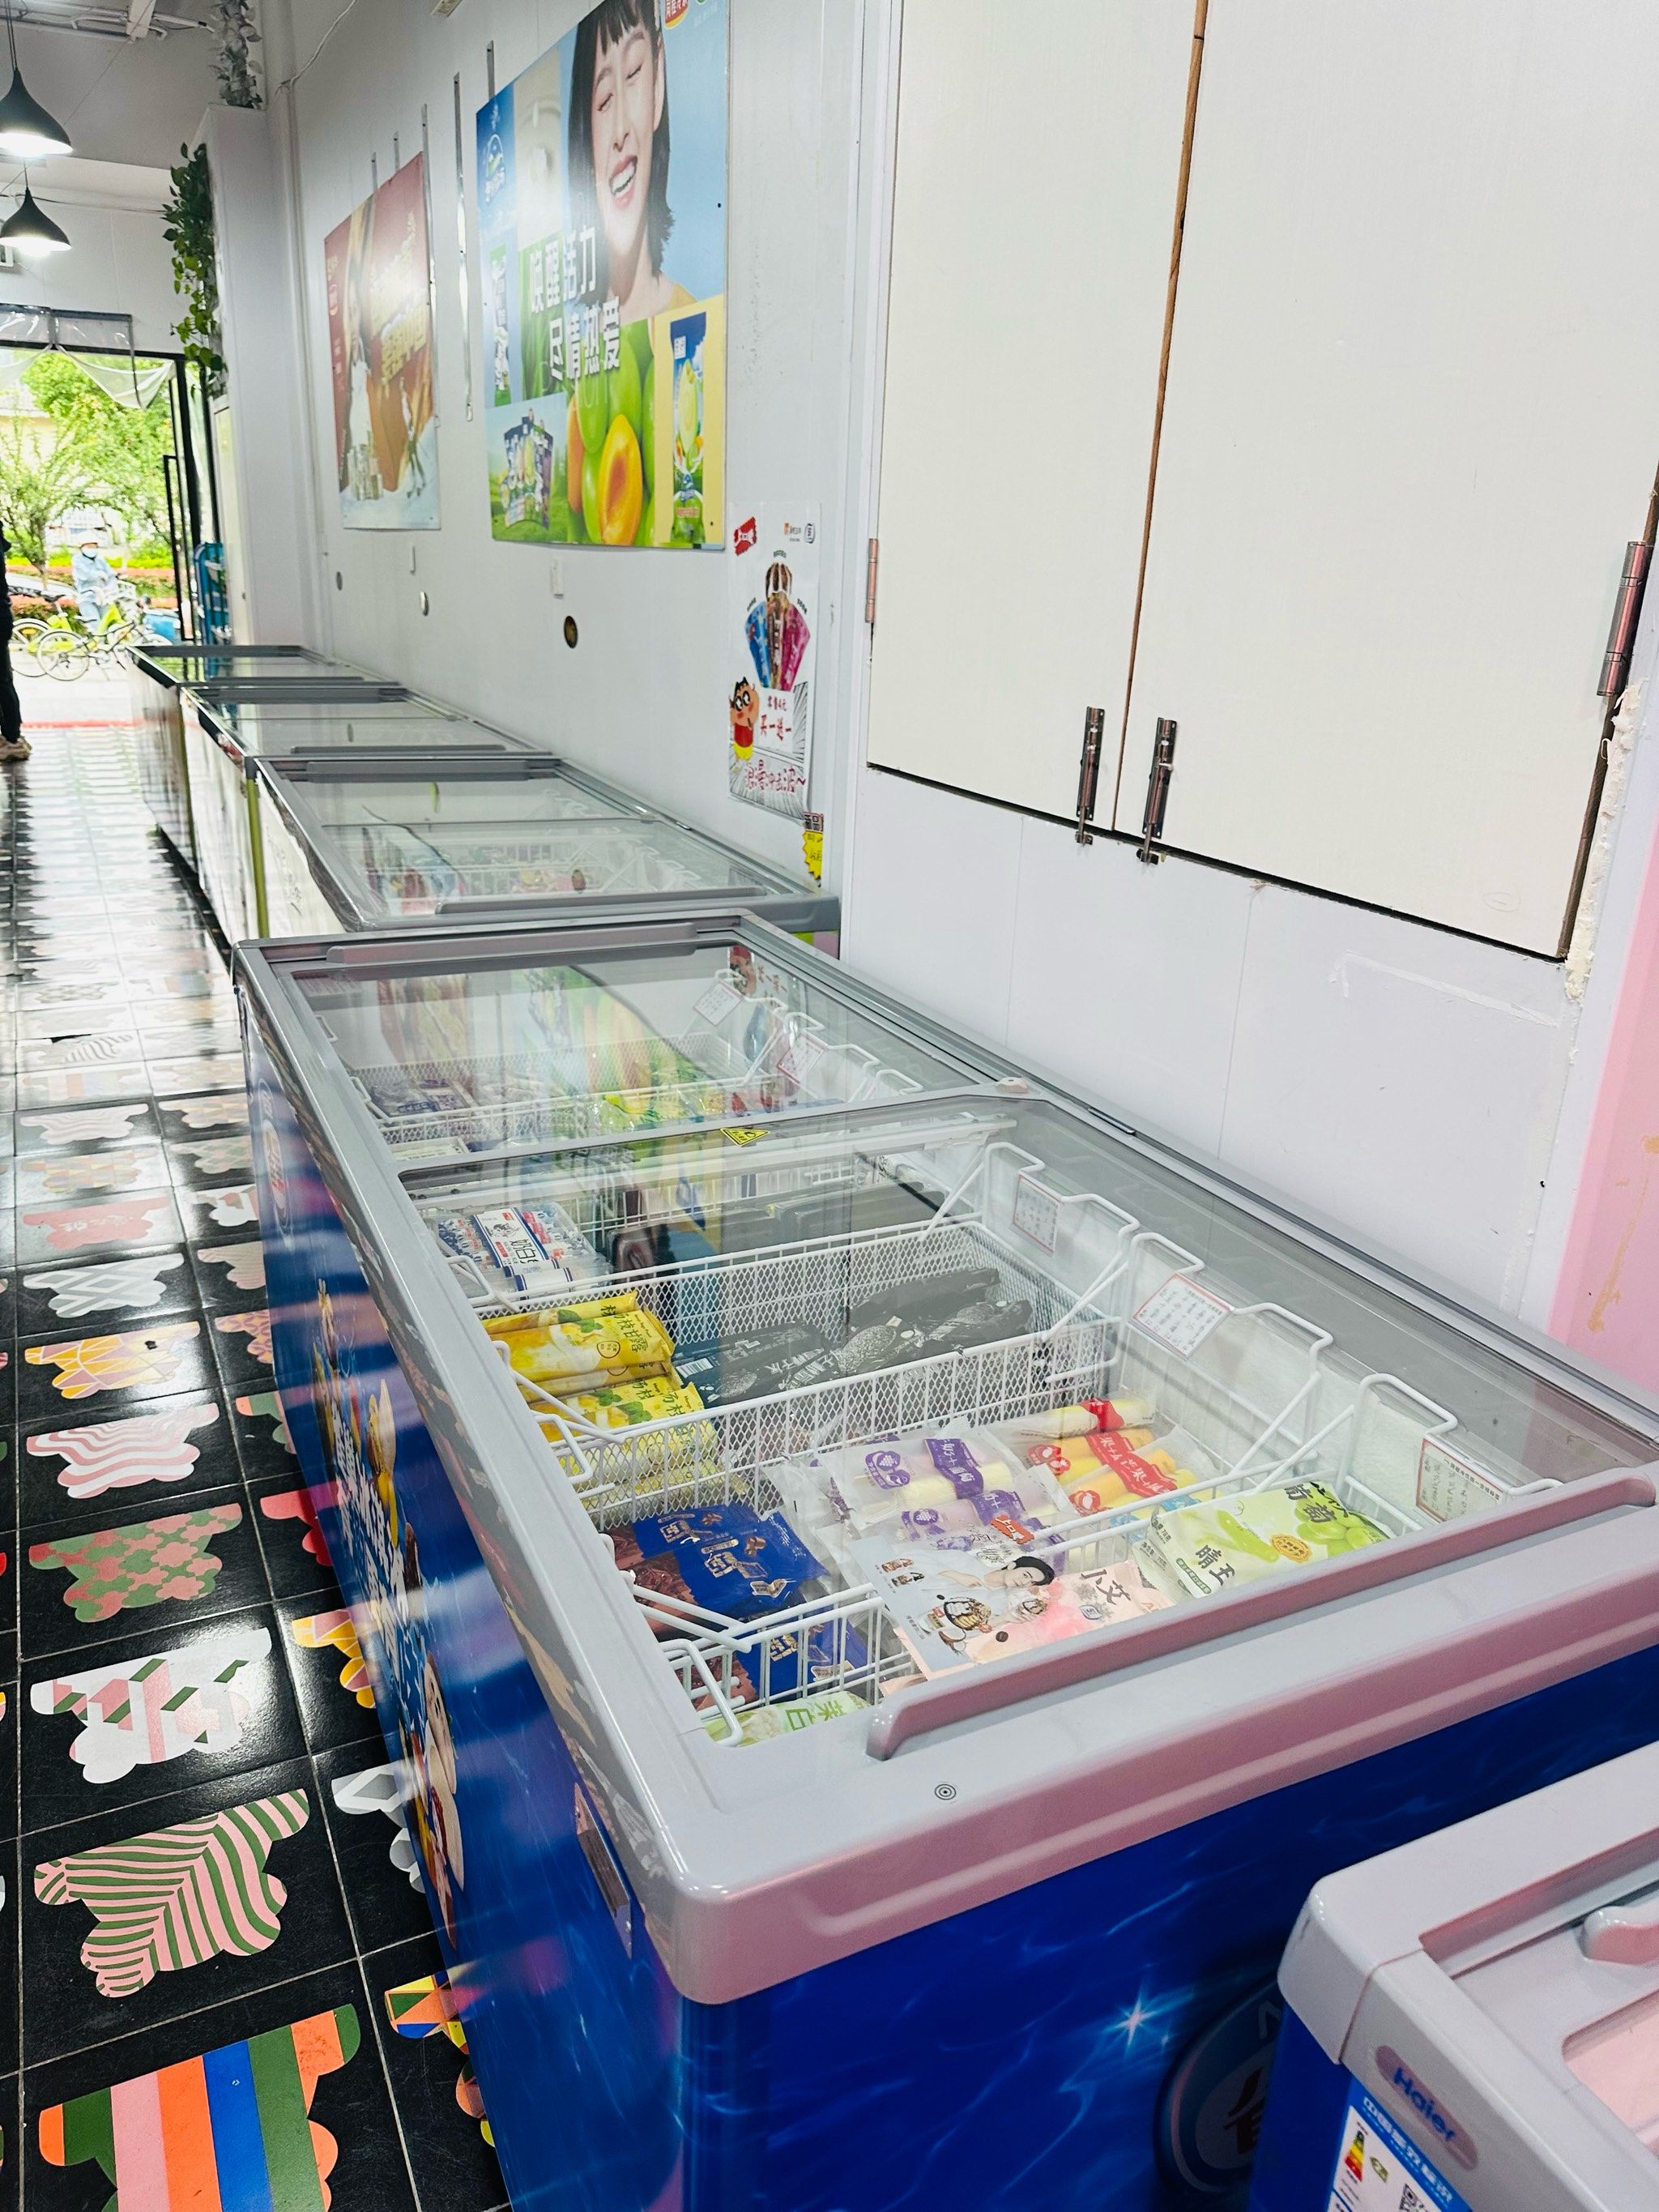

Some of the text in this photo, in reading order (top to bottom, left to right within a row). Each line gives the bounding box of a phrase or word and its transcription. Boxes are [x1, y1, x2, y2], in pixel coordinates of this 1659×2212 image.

[530, 224, 596, 314] 唤醒活力
[548, 296, 621, 382] 尽情热爱
[760, 715, 792, 741] 买一送一
[1284, 1484, 1337, 1524] 葡萄
[1195, 1544, 1235, 1586] 晴王
[1392, 2067, 1457, 2146] Haier
